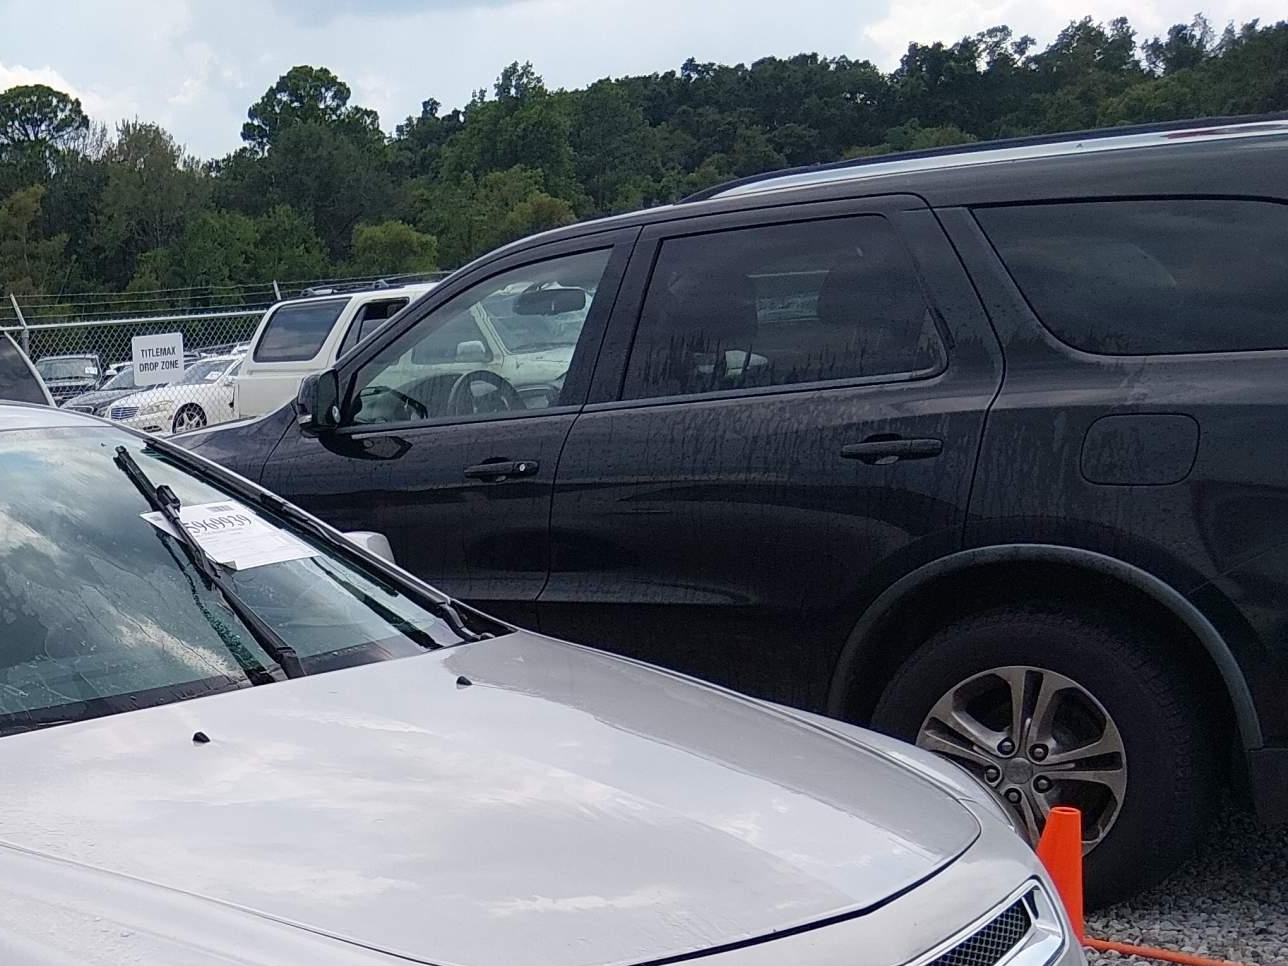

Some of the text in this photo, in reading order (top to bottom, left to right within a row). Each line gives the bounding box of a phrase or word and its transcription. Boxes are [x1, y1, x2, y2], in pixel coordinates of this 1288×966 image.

[140, 346, 176, 358] TITLEMAX
[139, 360, 179, 373] DROP ZONE
[183, 514, 252, 534] 5969939
